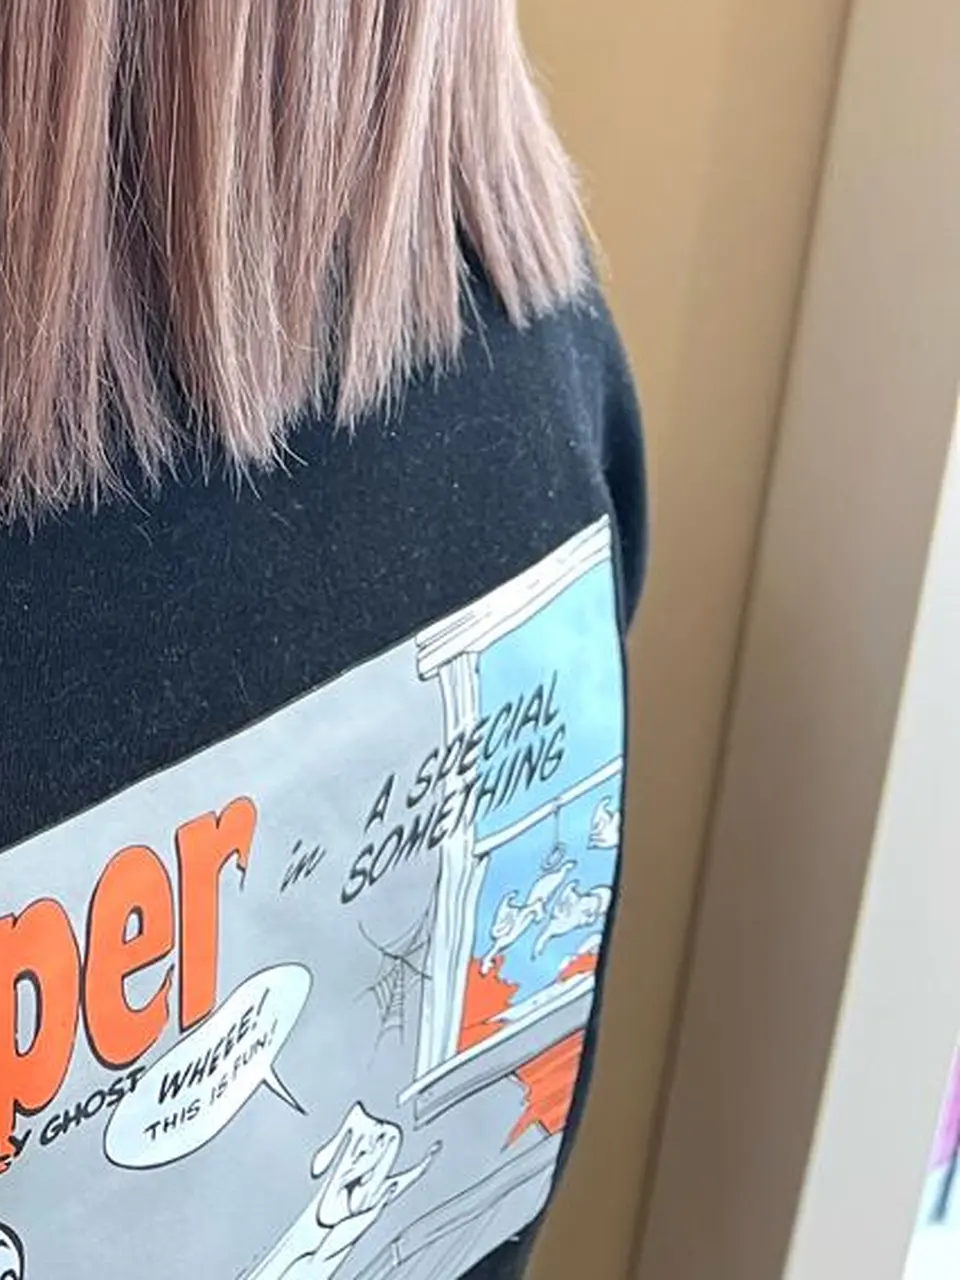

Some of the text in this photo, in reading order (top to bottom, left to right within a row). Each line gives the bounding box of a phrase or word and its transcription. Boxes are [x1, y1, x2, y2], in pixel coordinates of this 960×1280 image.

[341, 723, 566, 904] SOMETHING
[364, 669, 560, 833] A SPECIAL
[38, 1066, 146, 1146] GHOST
[143, 1018, 278, 1141] THIS IS FUN!
